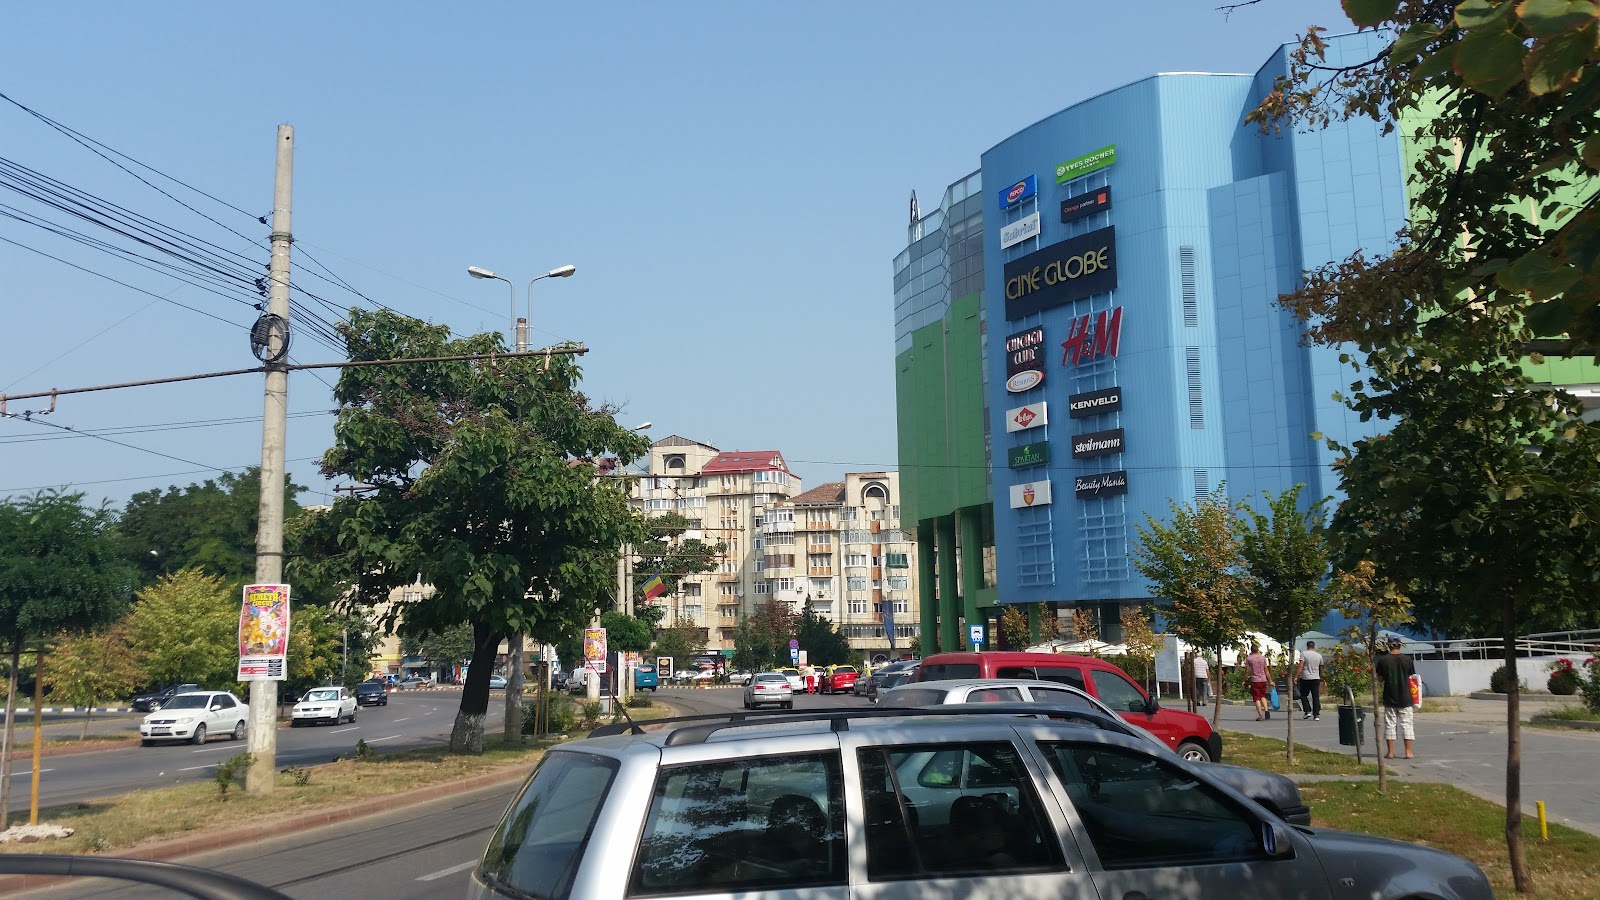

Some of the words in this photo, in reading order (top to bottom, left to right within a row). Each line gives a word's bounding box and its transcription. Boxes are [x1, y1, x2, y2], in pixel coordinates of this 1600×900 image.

[1065, 160, 1083, 172] YVES
[1084, 149, 1114, 164] ROCHER
[1009, 186, 1025, 198] PEPCO
[1079, 199, 1095, 208] partner
[1044, 246, 1108, 286] GLOBE
[1061, 306, 1123, 366] H&M
[1070, 395, 1119, 411] KENVELO
[1074, 438, 1120, 454] steilmann
[1014, 453, 1040, 464] SPARTAN
[1075, 479, 1100, 494] Beauty
[1101, 475, 1125, 488] Mania
